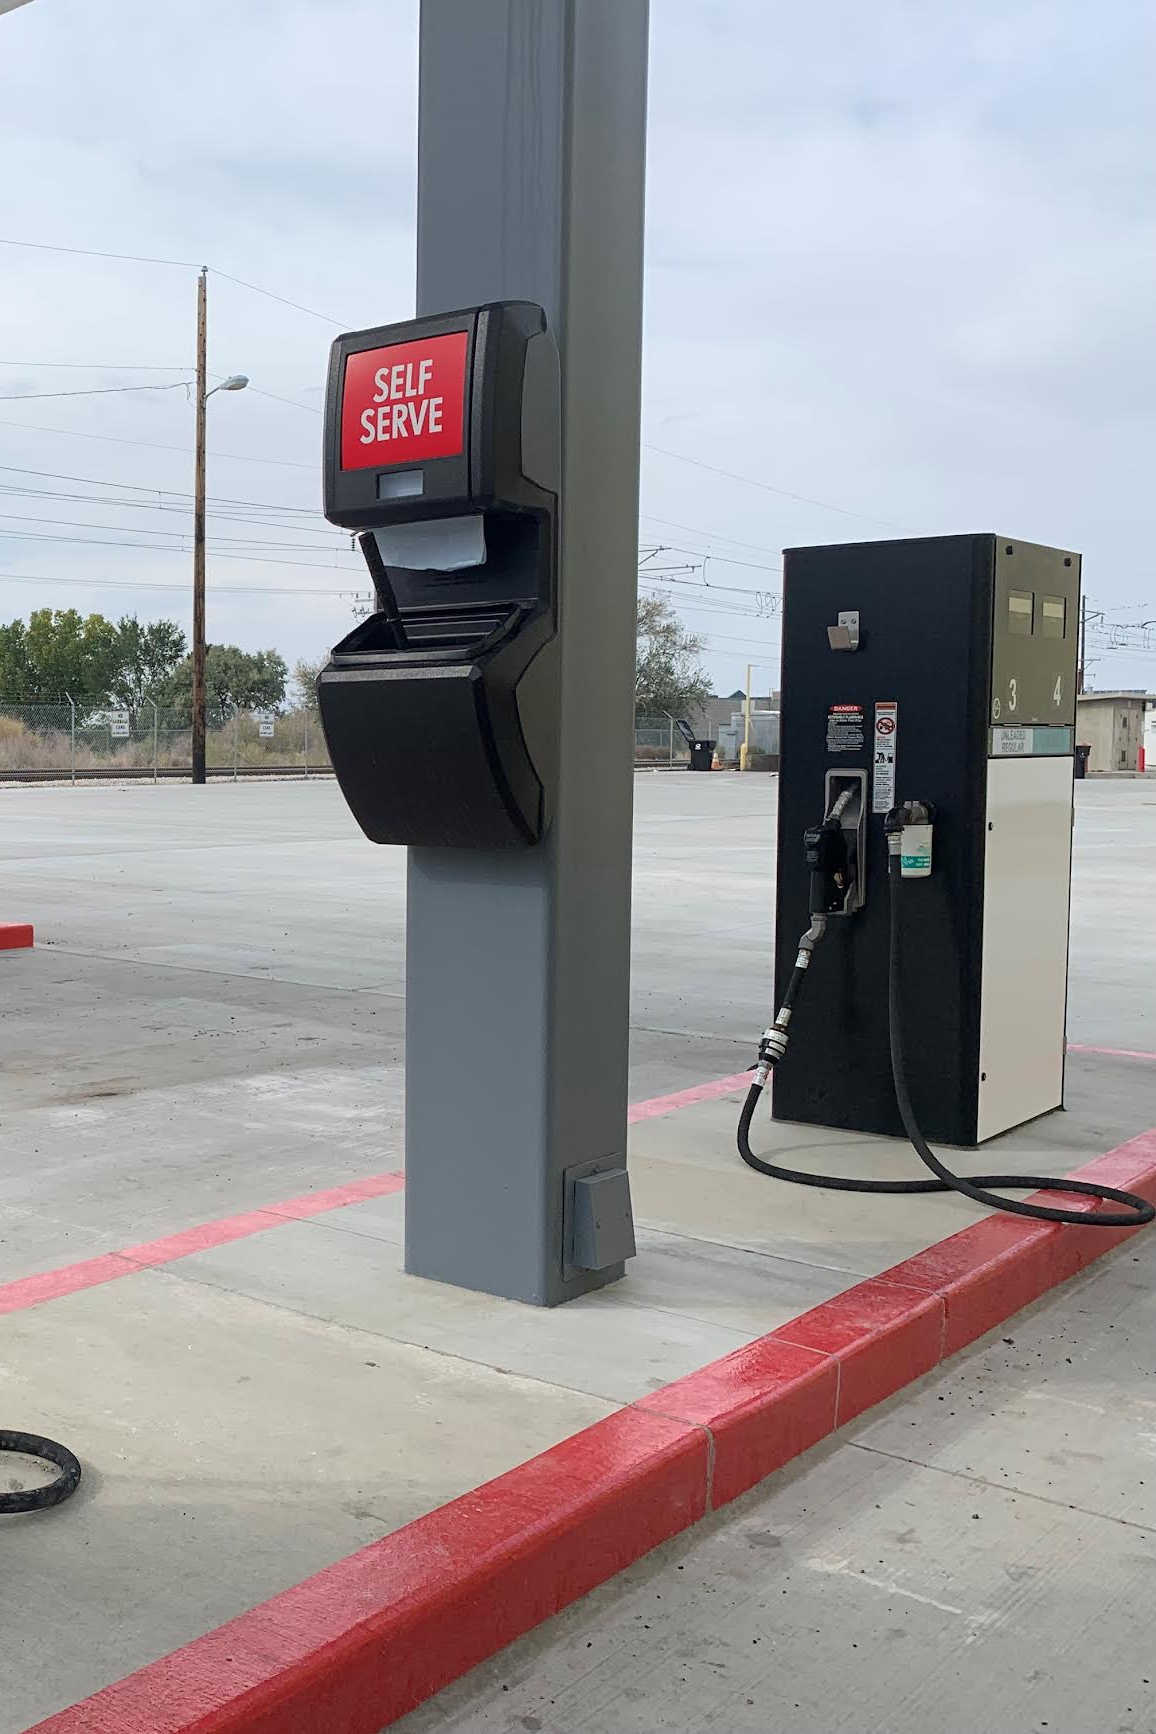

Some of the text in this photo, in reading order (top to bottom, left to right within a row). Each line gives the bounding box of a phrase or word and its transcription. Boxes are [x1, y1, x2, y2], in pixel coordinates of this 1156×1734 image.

[372, 359, 433, 403] SELF
[360, 397, 443, 445] SERVE
[1008, 678, 1017, 711] 3
[1053, 675, 1062, 707] 4
[1001, 729, 1026, 741] UNLEADED
[1001, 742, 1024, 753] REGULAR
